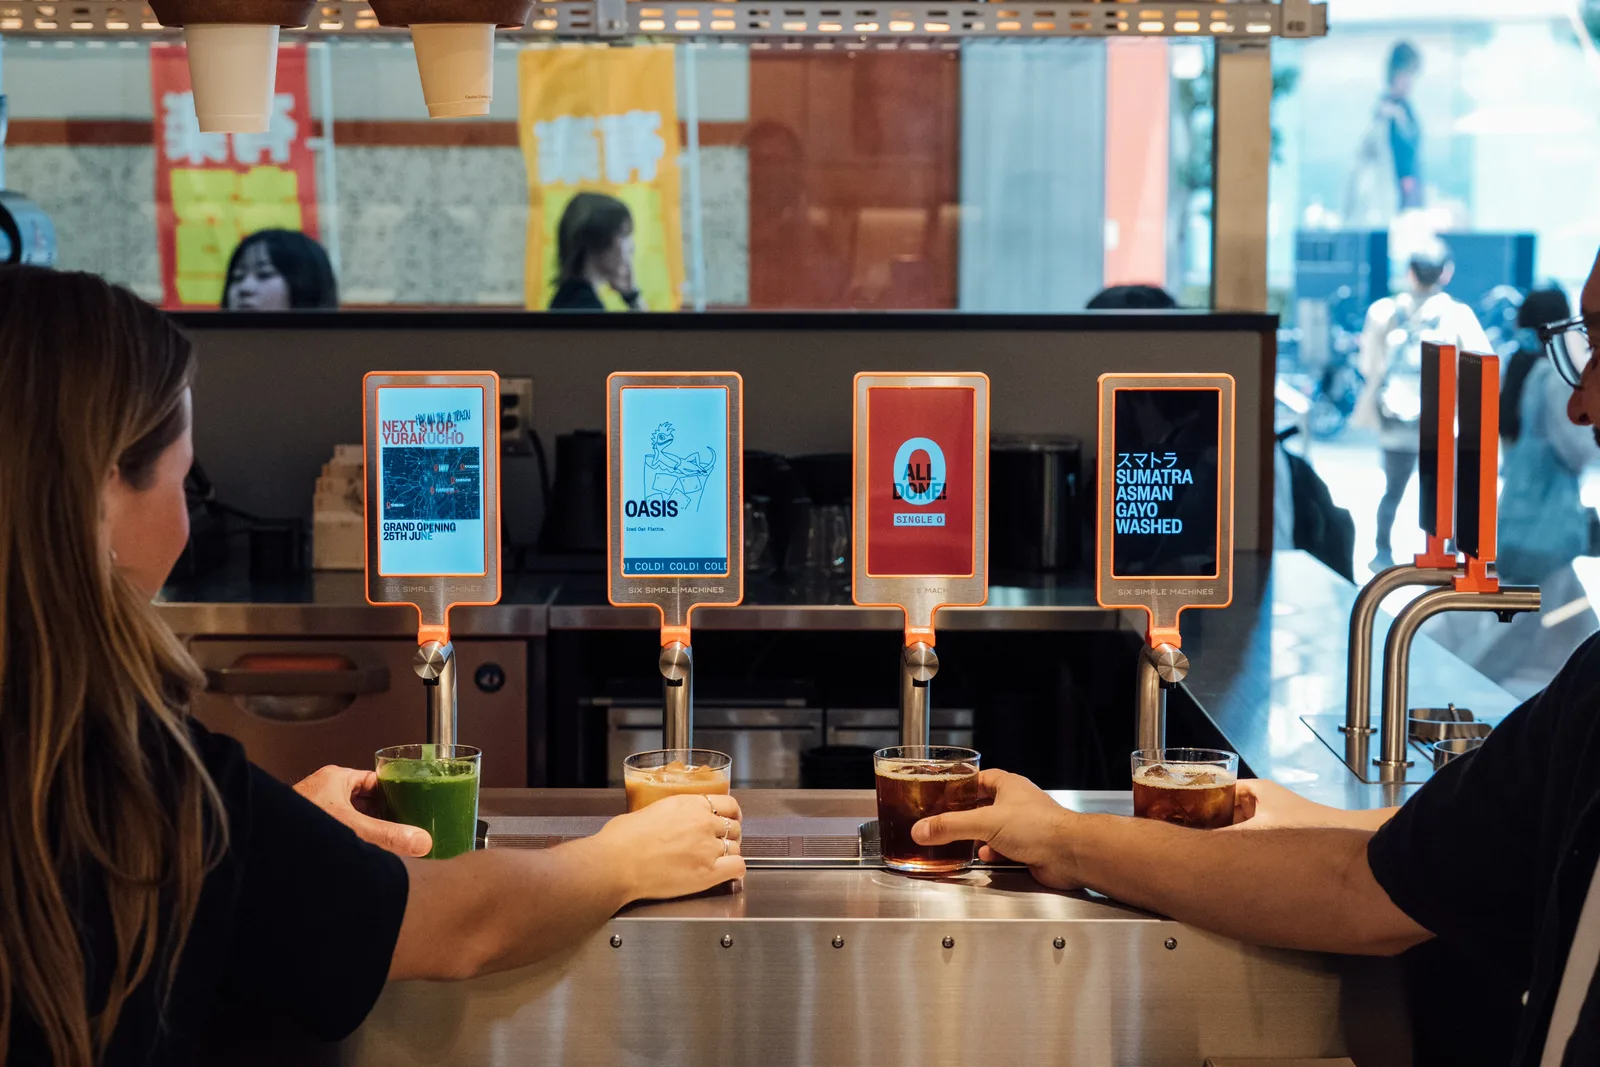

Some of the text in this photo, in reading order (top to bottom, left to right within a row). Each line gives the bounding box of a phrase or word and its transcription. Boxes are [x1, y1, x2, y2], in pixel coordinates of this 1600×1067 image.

[382, 420, 457, 434] NEXT STOP:
[382, 432, 464, 445] YURAKUCHO
[1117, 452, 1178, 468] スマトラ
[902, 463, 937, 481] ALL
[1116, 469, 1193, 484] SUMATRA
[892, 482, 947, 500] DONE!
[1115, 486, 1173, 501] ASMAN
[625, 499, 679, 518] OASIS
[1115, 502, 1159, 518] GAYO
[896, 515, 933, 524] SINGLE
[1115, 518, 1183, 534] WASHED
[383, 521, 457, 533] GRAND OPENING
[383, 531, 433, 541] 25TH JUNE
[634, 562, 665, 571] COLD!
[669, 562, 700, 571] COLD!
[385, 585, 400, 593] SIX
[402, 585, 435, 593] SIMPLE
[680, 586, 724, 594] MACHINES
[1118, 588, 1214, 596] SIX SIMPLE MACHINES
